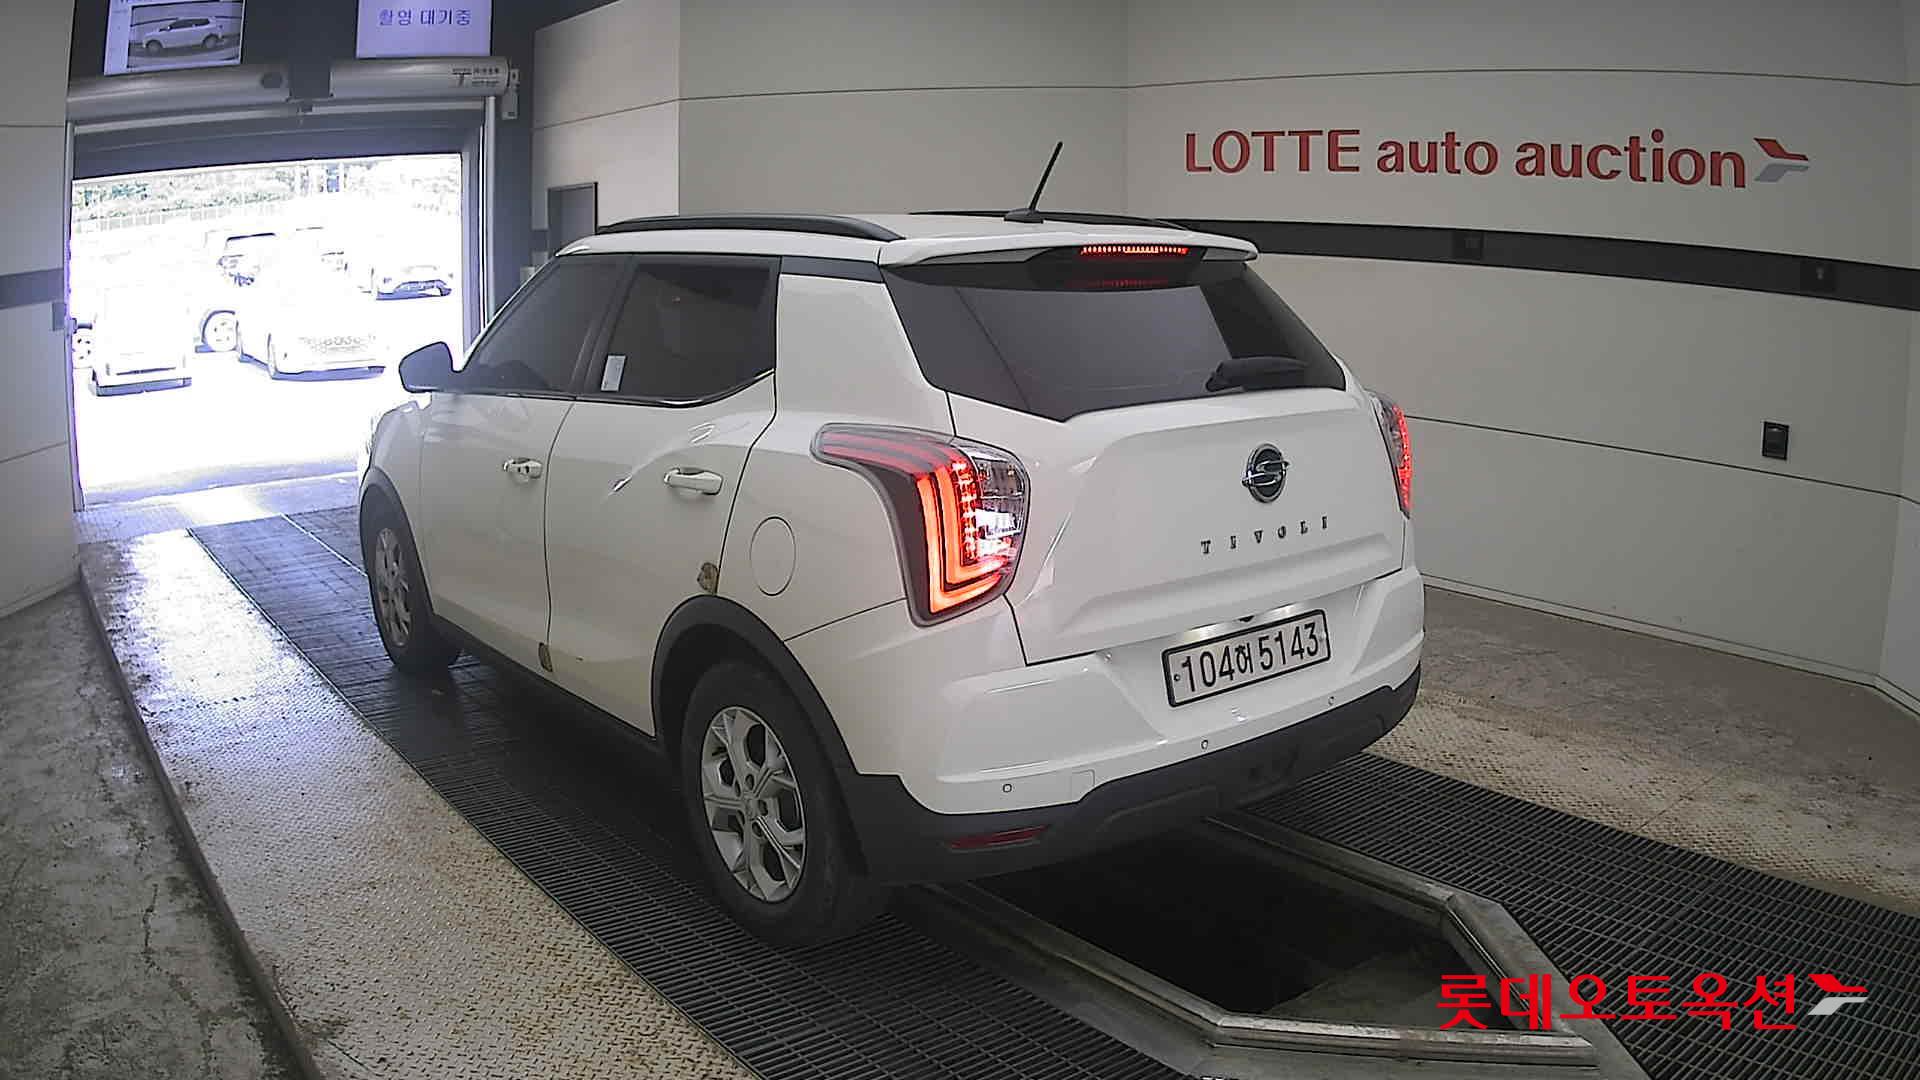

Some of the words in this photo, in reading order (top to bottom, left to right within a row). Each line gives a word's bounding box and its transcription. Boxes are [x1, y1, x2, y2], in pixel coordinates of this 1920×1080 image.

[420, 8, 471, 26] 대기중
[1185, 129, 1360, 174] LOTTE
[1376, 131, 1498, 176] auto
[1514, 128, 1745, 188] auction
[1200, 515, 1328, 554] TIVOLI
